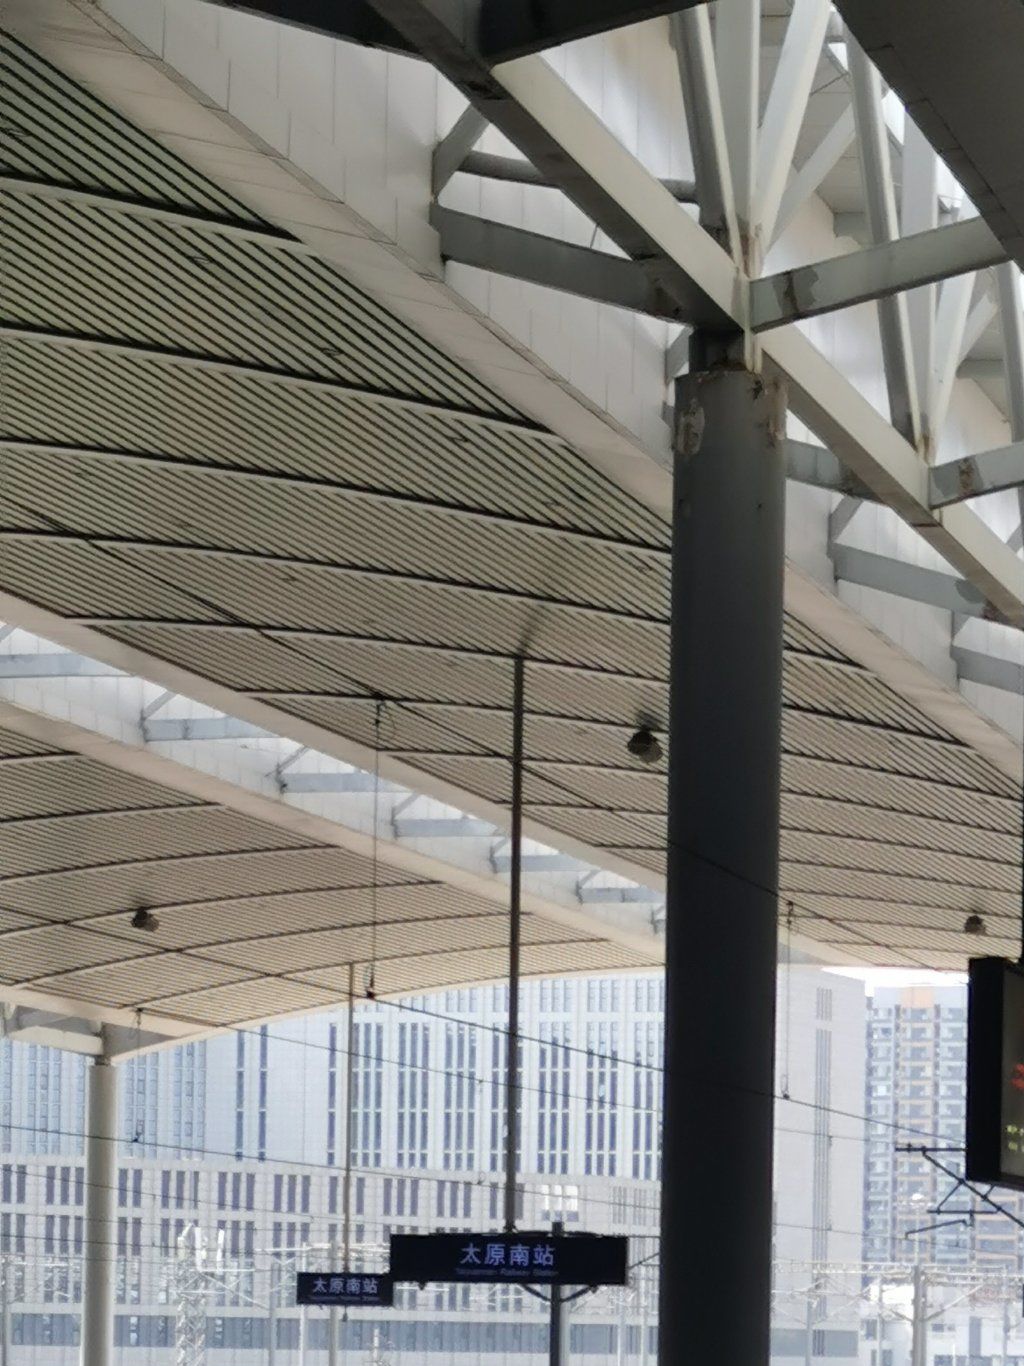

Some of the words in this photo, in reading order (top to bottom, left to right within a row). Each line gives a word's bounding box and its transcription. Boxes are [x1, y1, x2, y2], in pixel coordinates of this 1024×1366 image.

[460, 1243, 555, 1266] 太原南站
[312, 1276, 378, 1295] 太原南站
